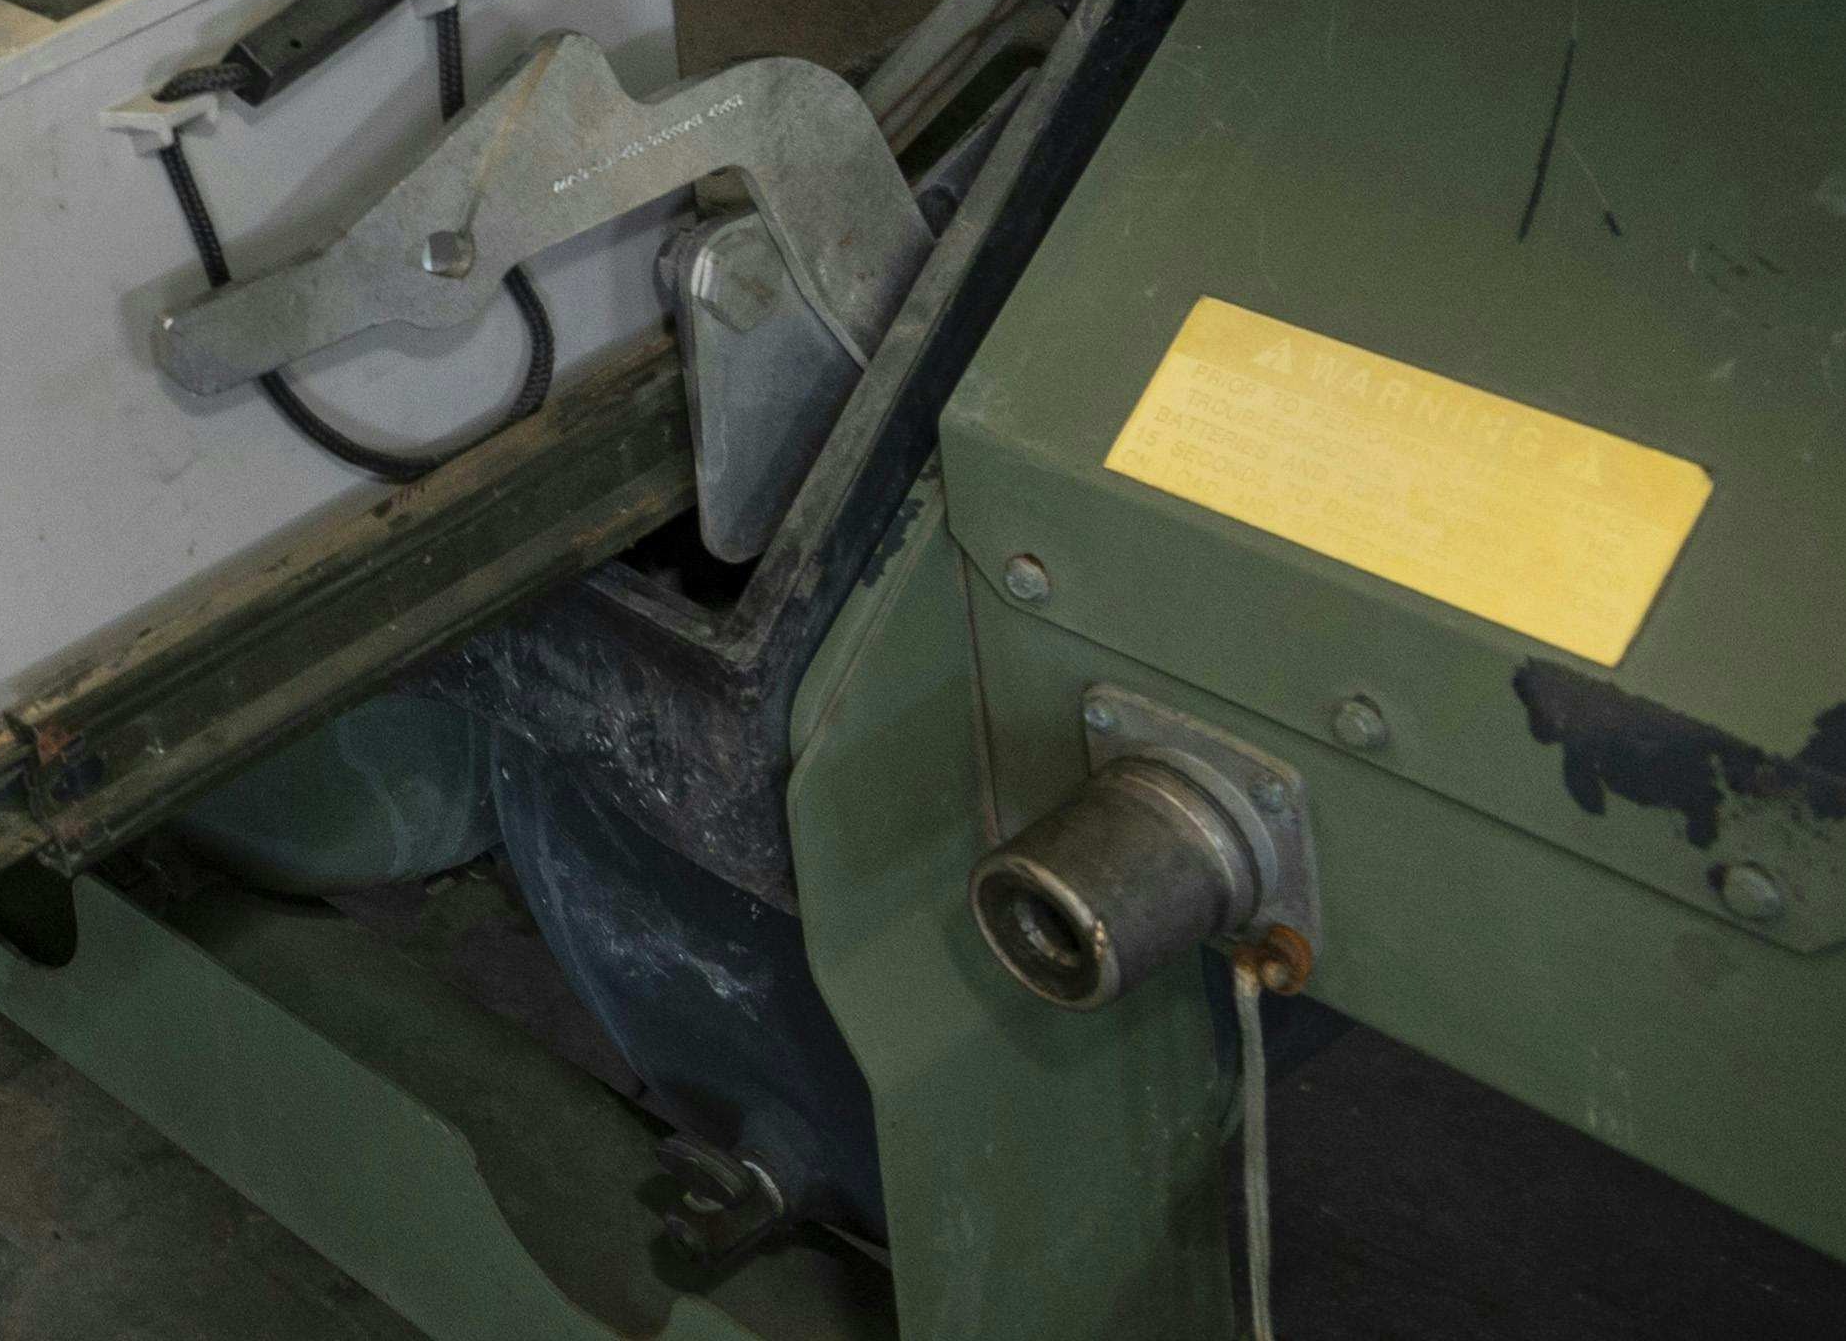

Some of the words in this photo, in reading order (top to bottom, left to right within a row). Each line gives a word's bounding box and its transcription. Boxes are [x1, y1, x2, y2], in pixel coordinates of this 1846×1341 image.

[1188, 362, 1261, 401] PRIOR
[1267, 391, 1303, 417] TO
[1302, 350, 1550, 463] WARNING
[1151, 403, 1274, 463] BATTERIES
[1277, 451, 1333, 485] AND
[1165, 438, 1274, 492] SECONDS
